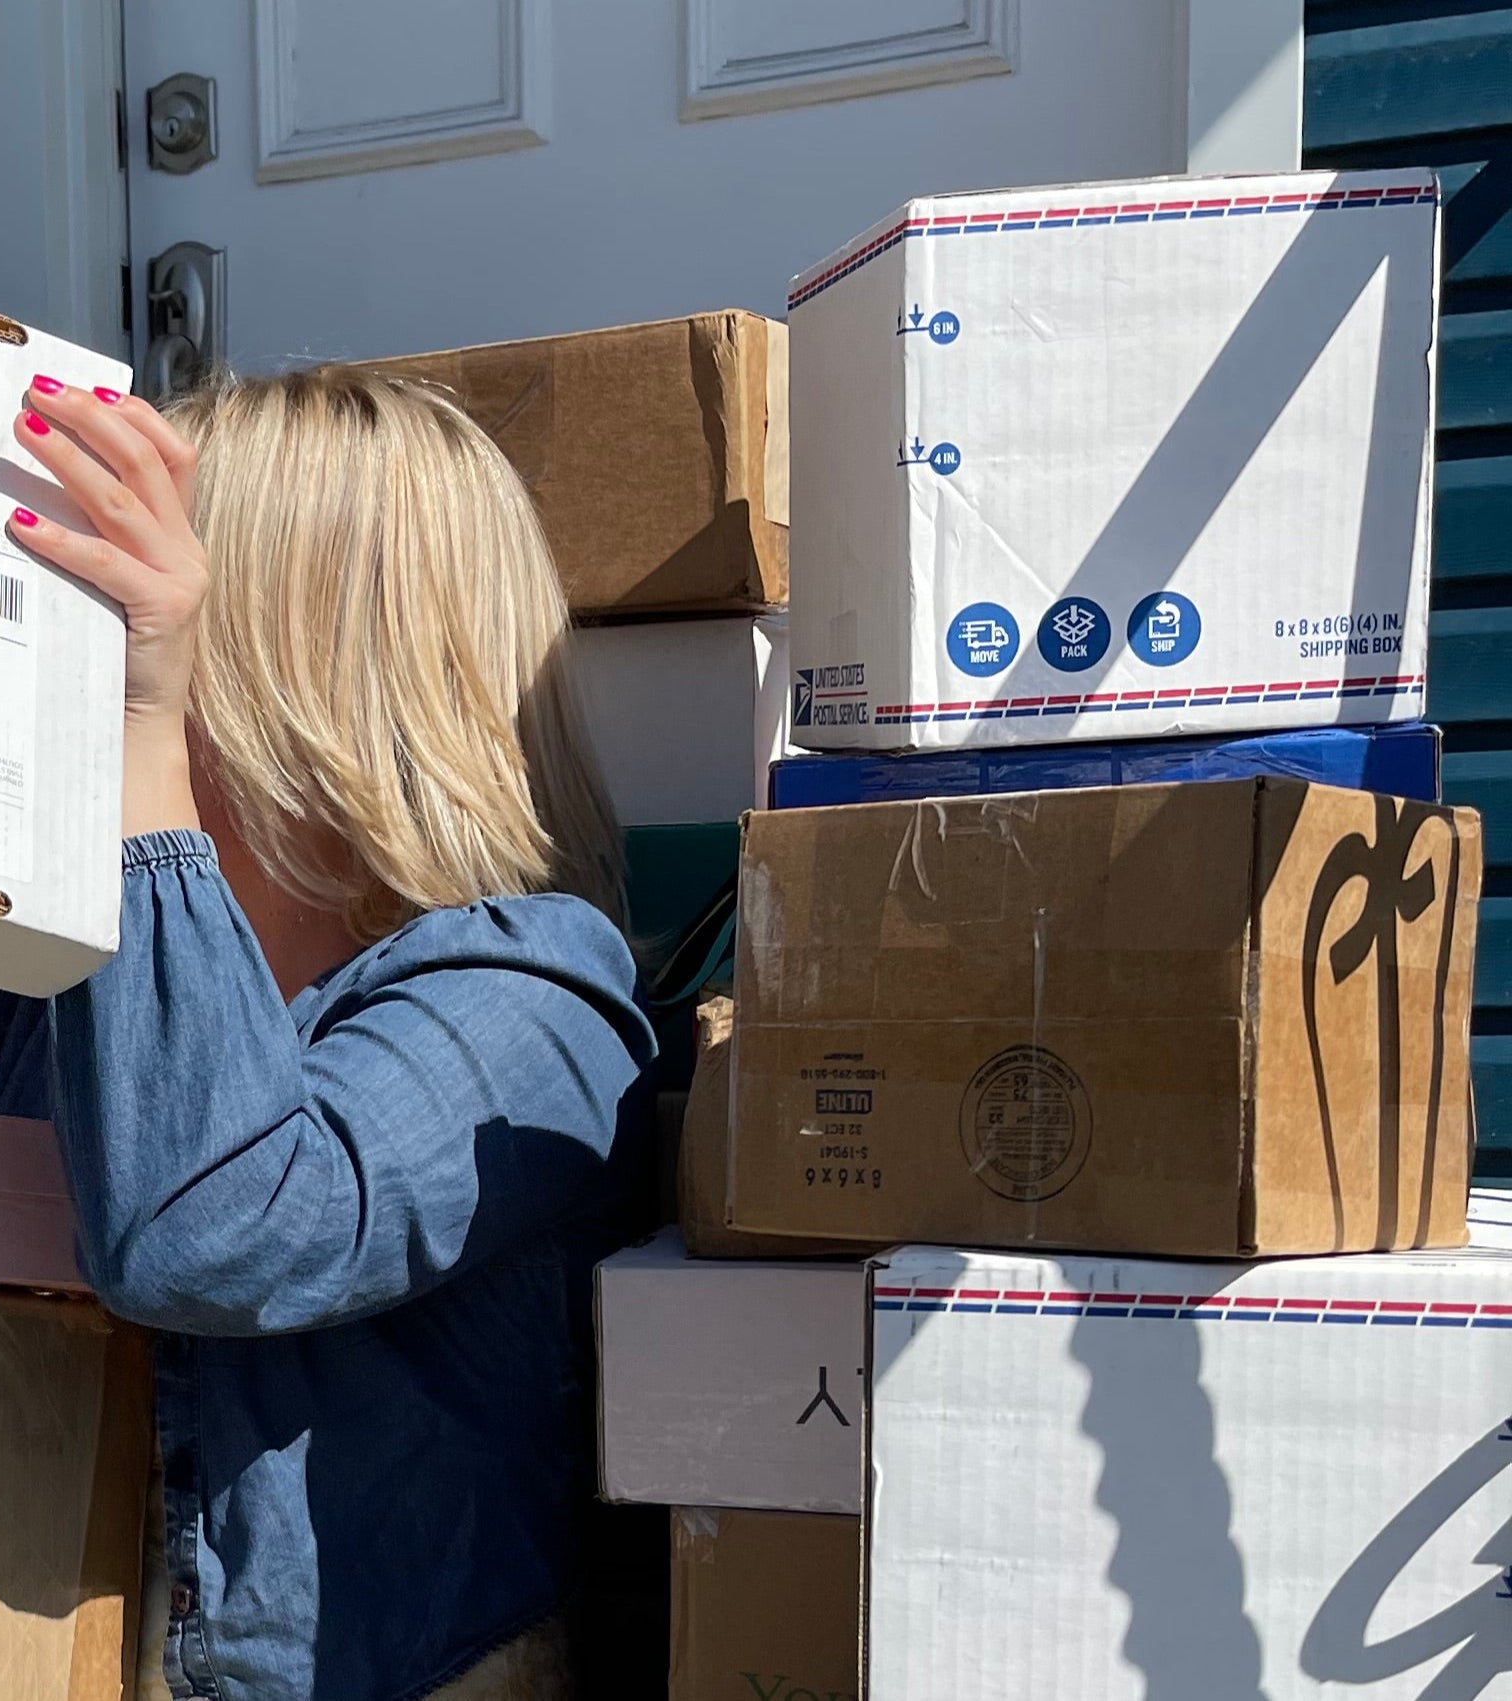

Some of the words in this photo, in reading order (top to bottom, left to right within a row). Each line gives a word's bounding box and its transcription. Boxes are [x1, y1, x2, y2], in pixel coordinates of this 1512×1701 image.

[933, 322, 941, 335] 6
[934, 453, 942, 465] 4
[1275, 620, 1284, 637] 8
[1299, 619, 1308, 636] 8
[1383, 613, 1402, 630] IN.
[1061, 644, 1088, 658] PACK
[1151, 640, 1176, 653] SHIP
[1300, 638, 1368, 658] SHIPPING
[1372, 636, 1402, 654] BOX
[970, 650, 1000, 664] MOVE
[815, 666, 839, 689] UNITED
[840, 662, 865, 687] STATES
[813, 704, 838, 726] POSTAL
[818, 1091, 870, 1112] ULINE
[805, 1168, 815, 1186] 6
[839, 1168, 848, 1188] 6
